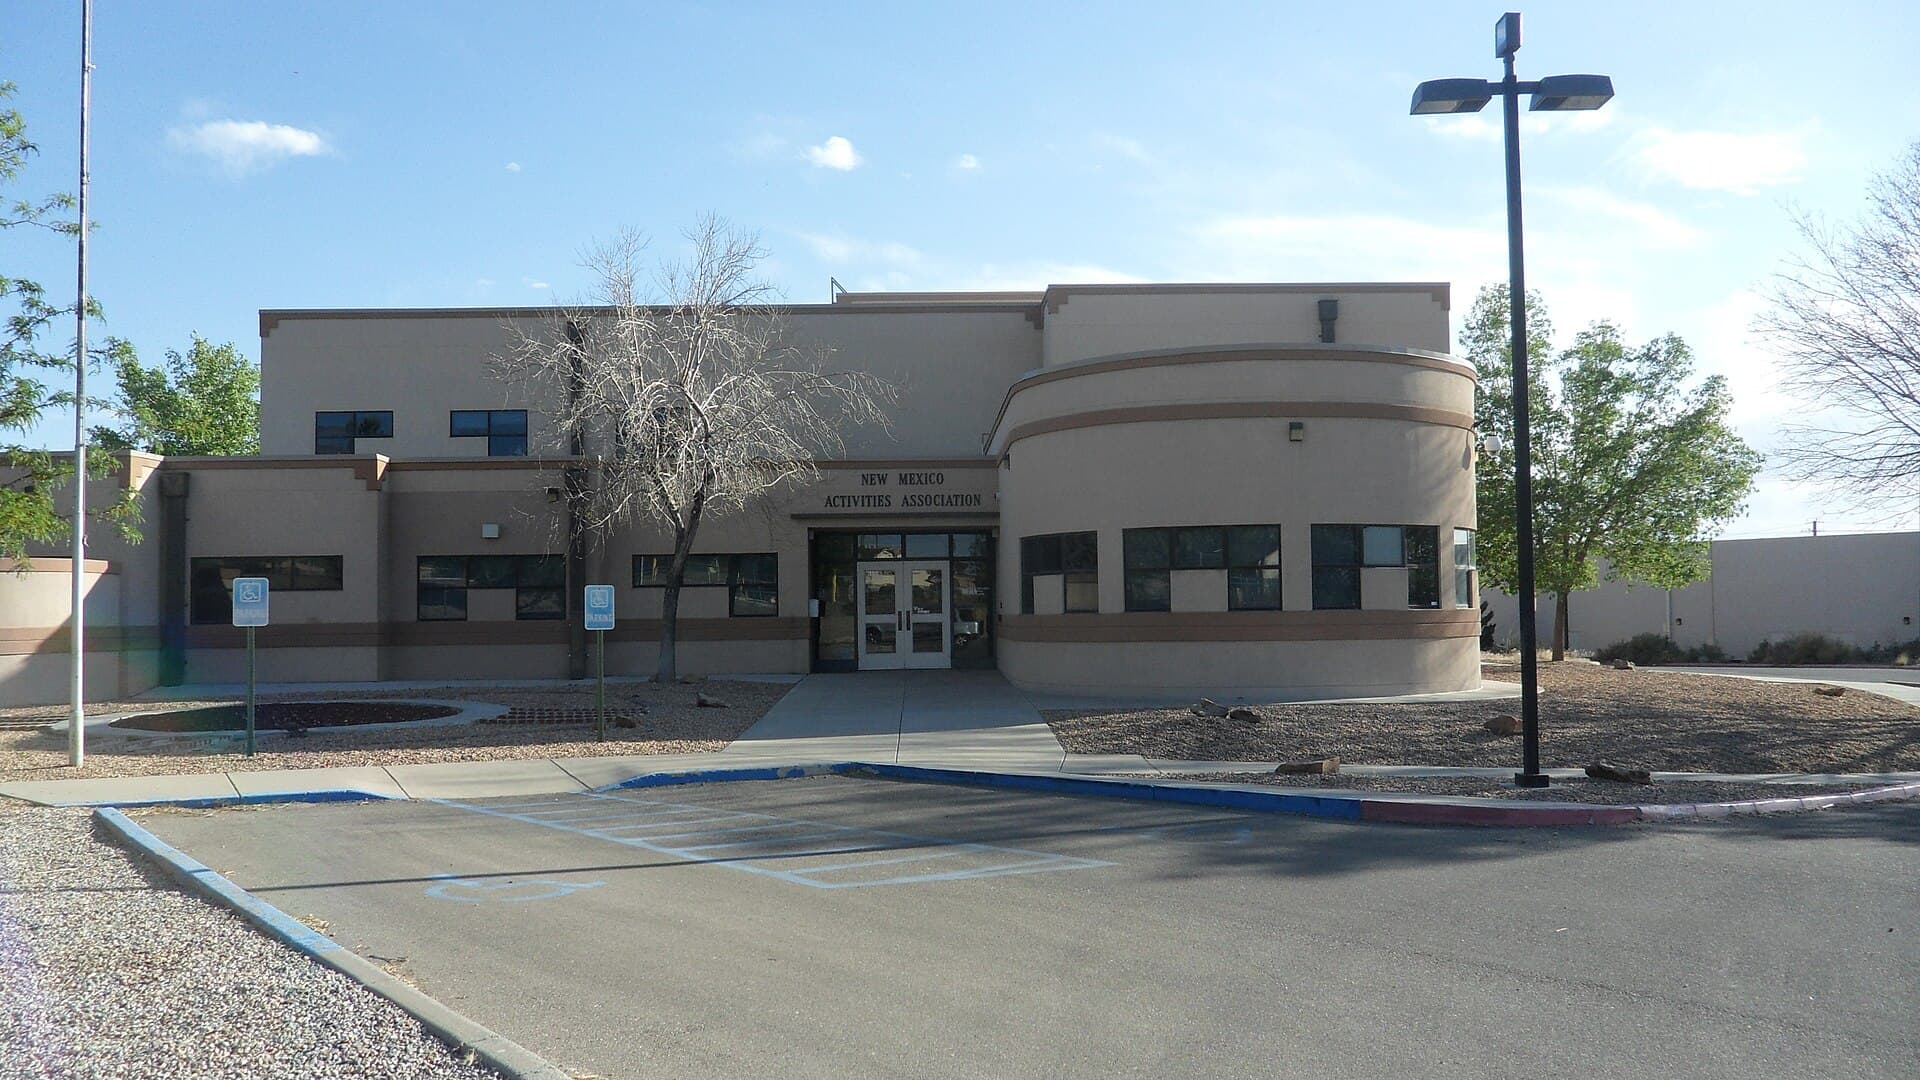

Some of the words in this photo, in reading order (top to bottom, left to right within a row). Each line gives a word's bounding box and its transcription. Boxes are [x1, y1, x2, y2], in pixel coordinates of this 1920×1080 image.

[861, 473, 889, 486] NEW
[898, 472, 945, 486] MEXICO
[824, 495, 892, 508] ACTIVITIES
[901, 494, 982, 507] ASSOCIATION
